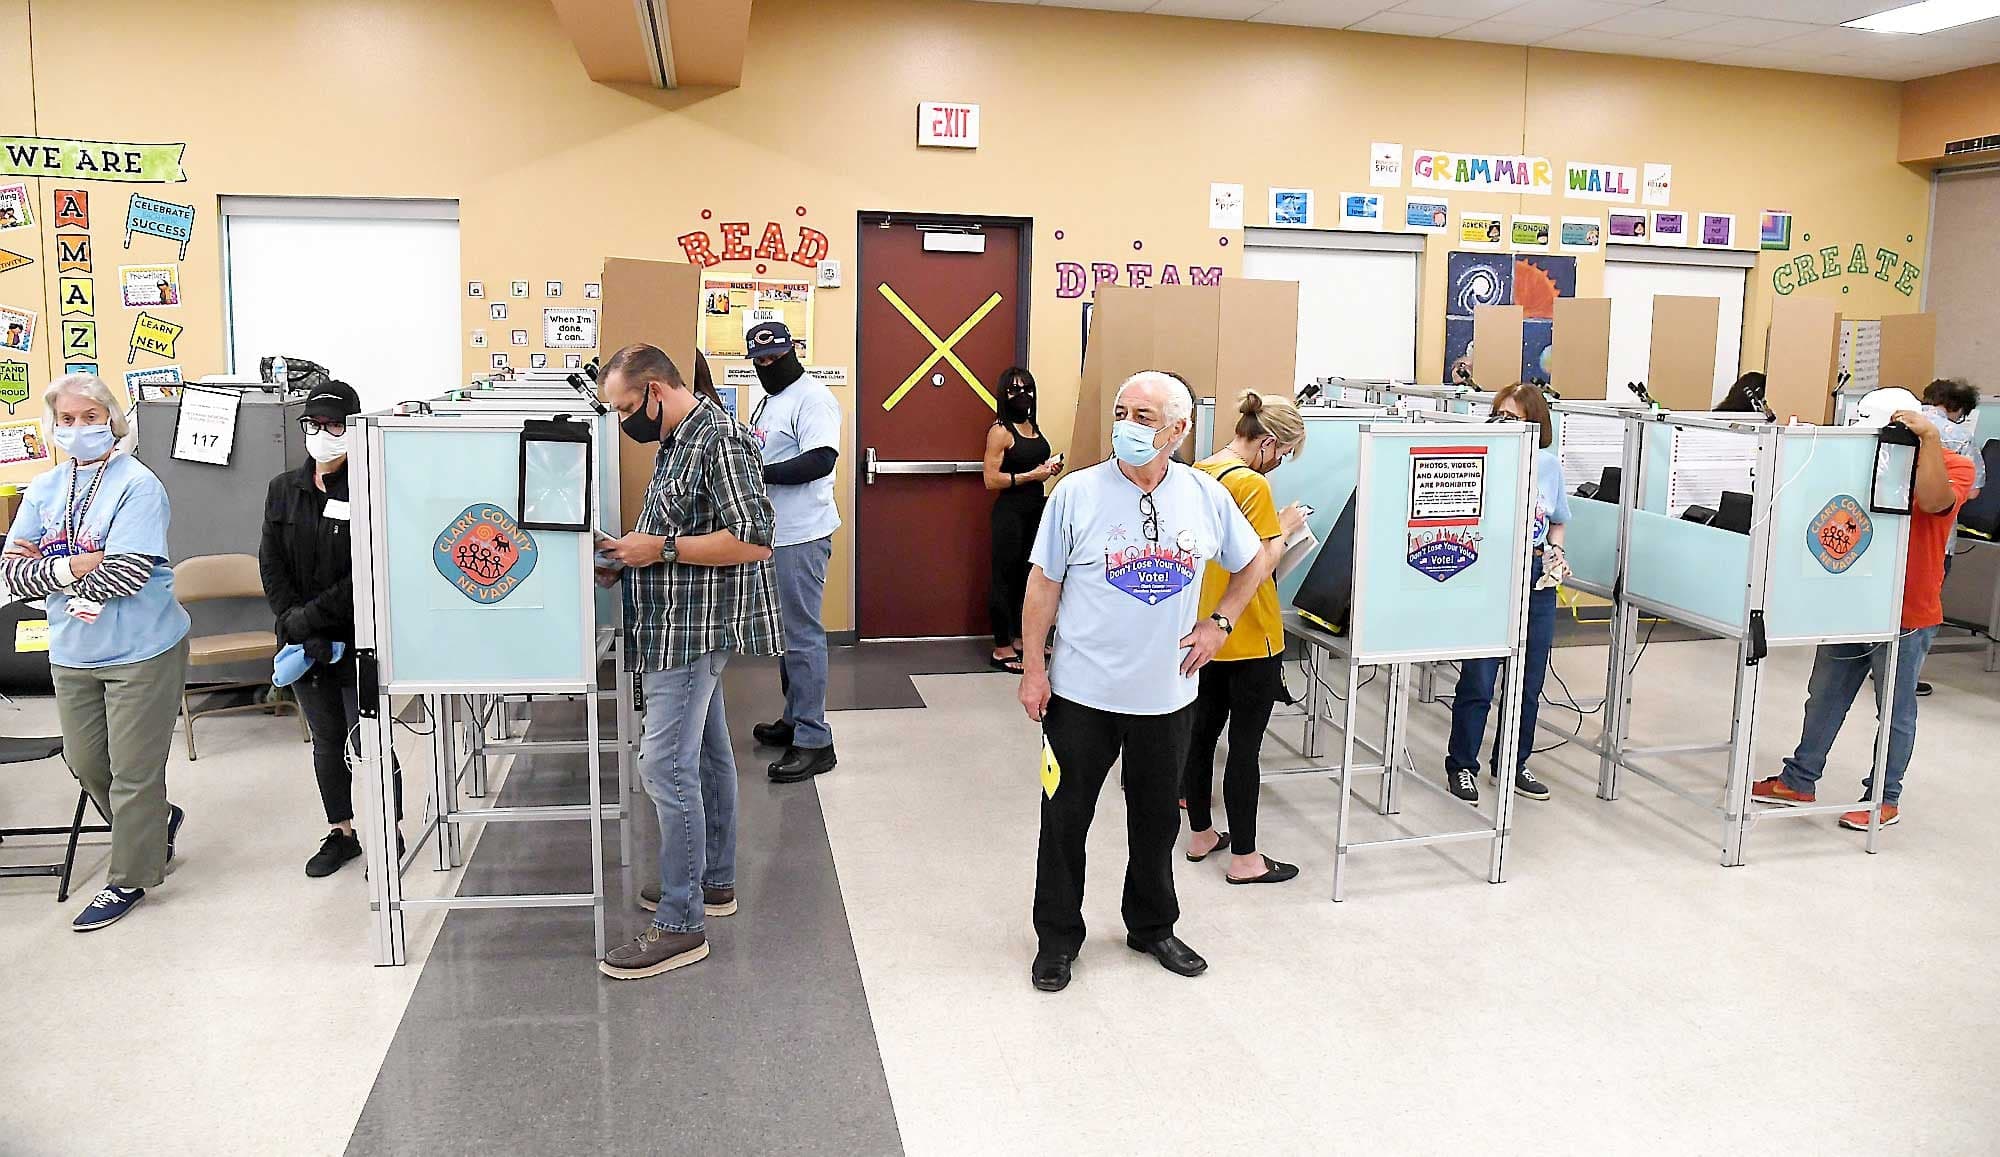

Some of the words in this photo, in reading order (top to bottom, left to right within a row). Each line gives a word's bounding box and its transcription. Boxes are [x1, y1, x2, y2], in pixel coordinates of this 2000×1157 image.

[932, 107, 970, 138] EXIT
[6, 145, 61, 168] WE
[76, 149, 142, 173] ARE
[1414, 155, 1552, 186] GRAMMAR
[1569, 168, 1629, 194] WALL
[134, 200, 191, 219] CELEBRATE
[131, 217, 187, 238] SUCCESS
[677, 221, 829, 269] READ
[1055, 262, 1223, 298] DREAM
[1772, 243, 1921, 296] CREATE
[141, 318, 174, 335] LEARN
[549, 315, 575, 323] When
[576, 315, 592, 323] I'm
[136, 335, 168, 352] NEW
[192, 432, 219, 447] 117
[1811, 501, 1838, 534] CLARK
[1841, 498, 1871, 533] COUNTY
[439, 511, 478, 553] CLARK
[481, 508, 532, 552] COUNTY
[1427, 543, 1443, 553] Lose
[1443, 541, 1459, 552] Your
[1109, 563, 1131, 580] Don't
[1132, 560, 1153, 571] Lose
[1154, 558, 1175, 570] Your
[1431, 554, 1454, 565] Vote!
[1819, 551, 1859, 570] NEVADA
[1137, 571, 1169, 582] Vote!
[456, 575, 518, 600] NEVADA
